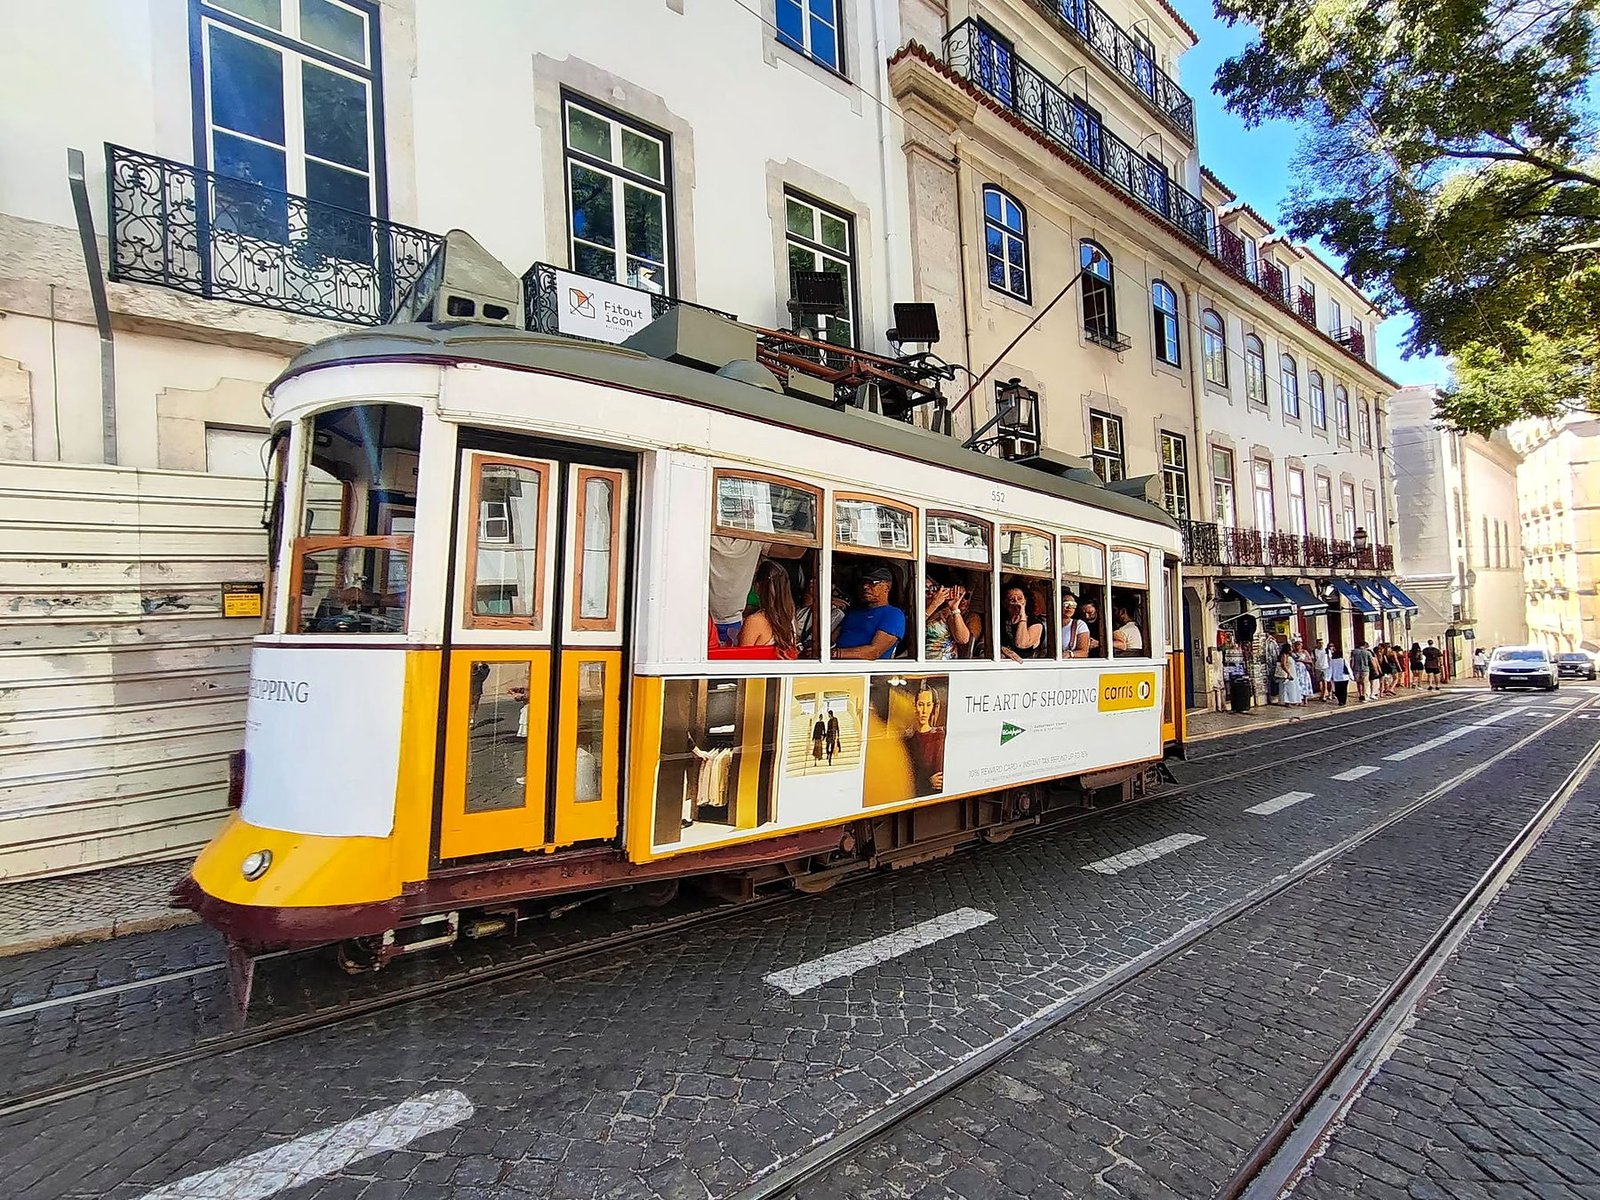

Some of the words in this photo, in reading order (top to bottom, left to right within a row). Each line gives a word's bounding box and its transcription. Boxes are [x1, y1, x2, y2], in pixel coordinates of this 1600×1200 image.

[604, 301, 643, 319] Fitout
[605, 313, 633, 327] icon
[991, 490, 1006, 503] 552
[1104, 681, 1134, 700] carris
[965, 695, 990, 713] THE
[993, 693, 1020, 711] ART
[1022, 692, 1038, 709] OF
[1040, 688, 1097, 707] SHOPPING
